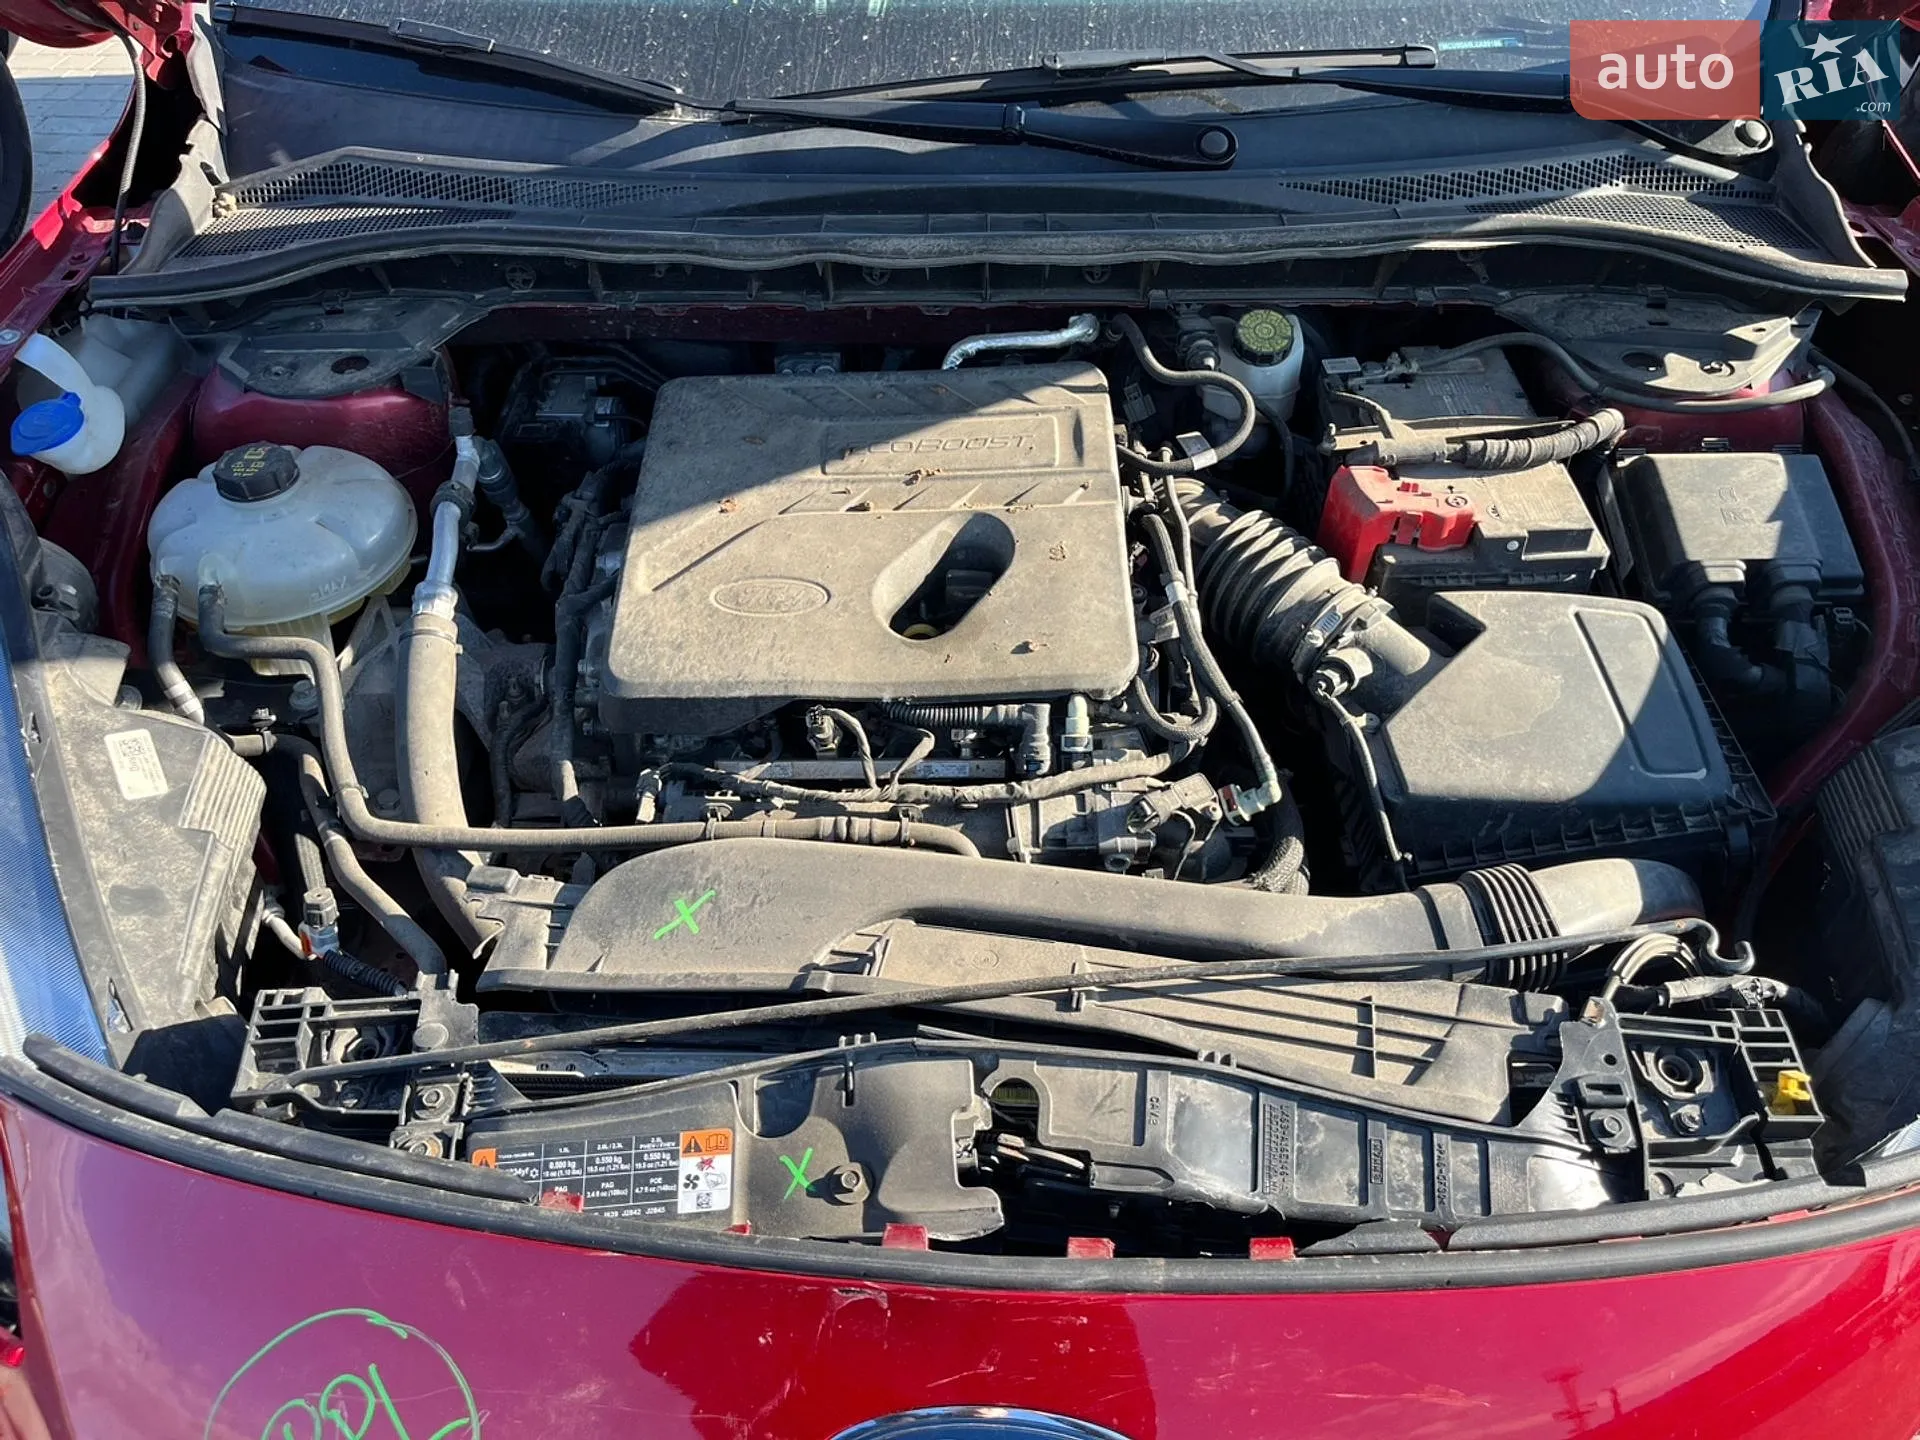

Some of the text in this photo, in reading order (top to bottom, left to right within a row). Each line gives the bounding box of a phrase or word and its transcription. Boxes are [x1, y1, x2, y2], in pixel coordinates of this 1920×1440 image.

[847, 435, 1033, 455] ECOBOOST
[613, 1156, 623, 1164] kg
[662, 1152, 671, 1160] kg
[567, 1160, 577, 1169] kg
